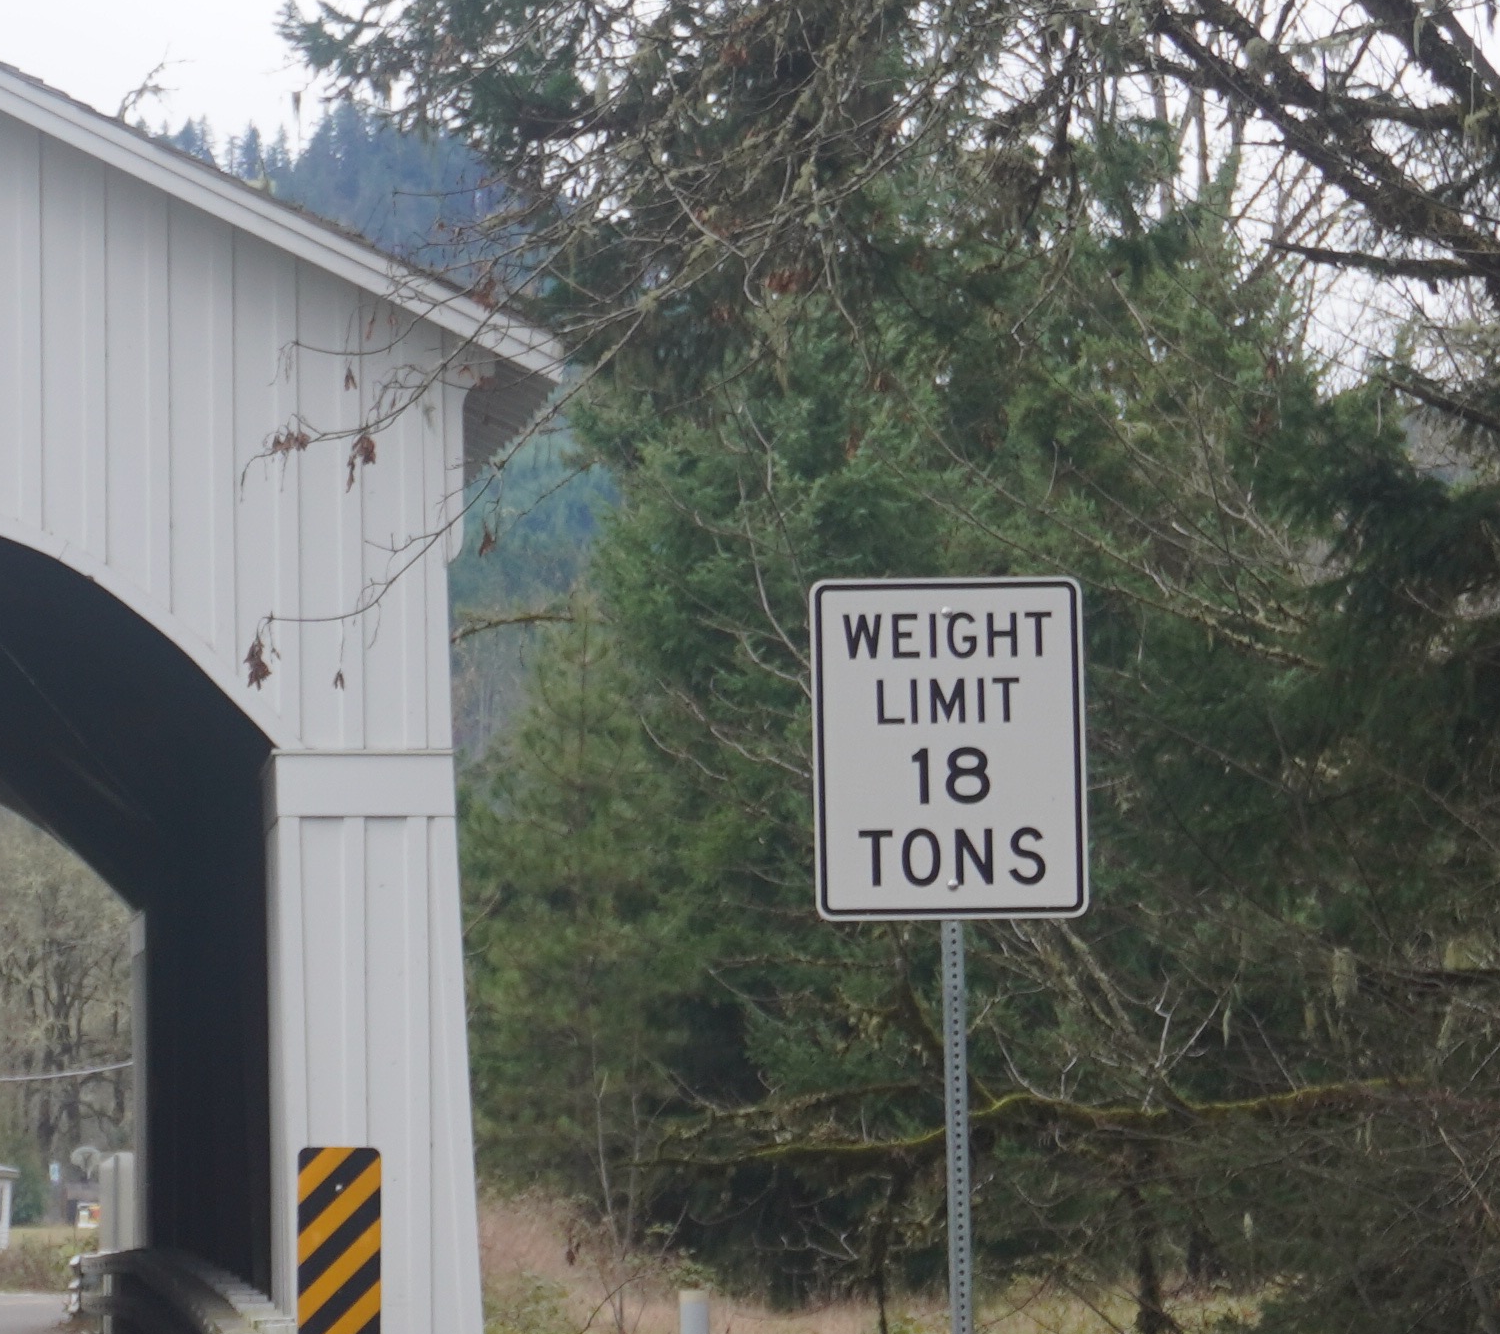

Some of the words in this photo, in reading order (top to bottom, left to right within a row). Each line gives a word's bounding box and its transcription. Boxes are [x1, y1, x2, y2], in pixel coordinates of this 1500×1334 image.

[842, 611, 1053, 660] WEIGHT
[875, 676, 1020, 725] LIMIT
[911, 746, 991, 805] 18
[857, 826, 1047, 887] TONS
